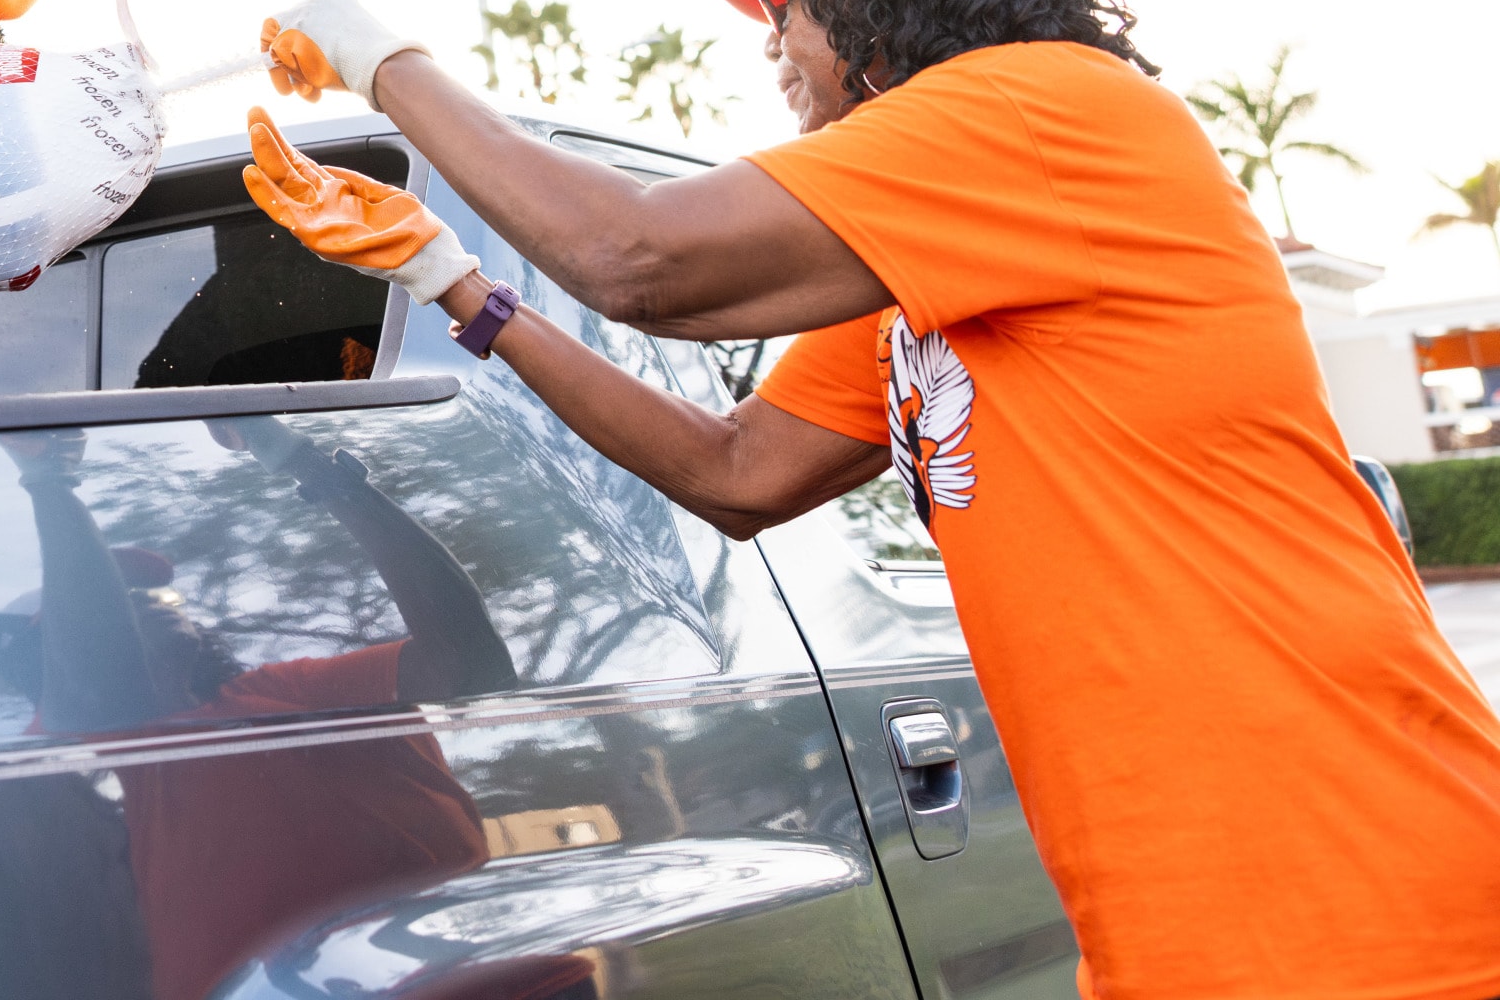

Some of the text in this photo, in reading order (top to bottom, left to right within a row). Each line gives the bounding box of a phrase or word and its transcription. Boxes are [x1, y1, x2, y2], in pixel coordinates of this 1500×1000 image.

[0, 51, 24, 78] BROOK
[72, 76, 122, 118] frozen
[80, 115, 133, 160] frozen
[127, 122, 150, 143] frozen
